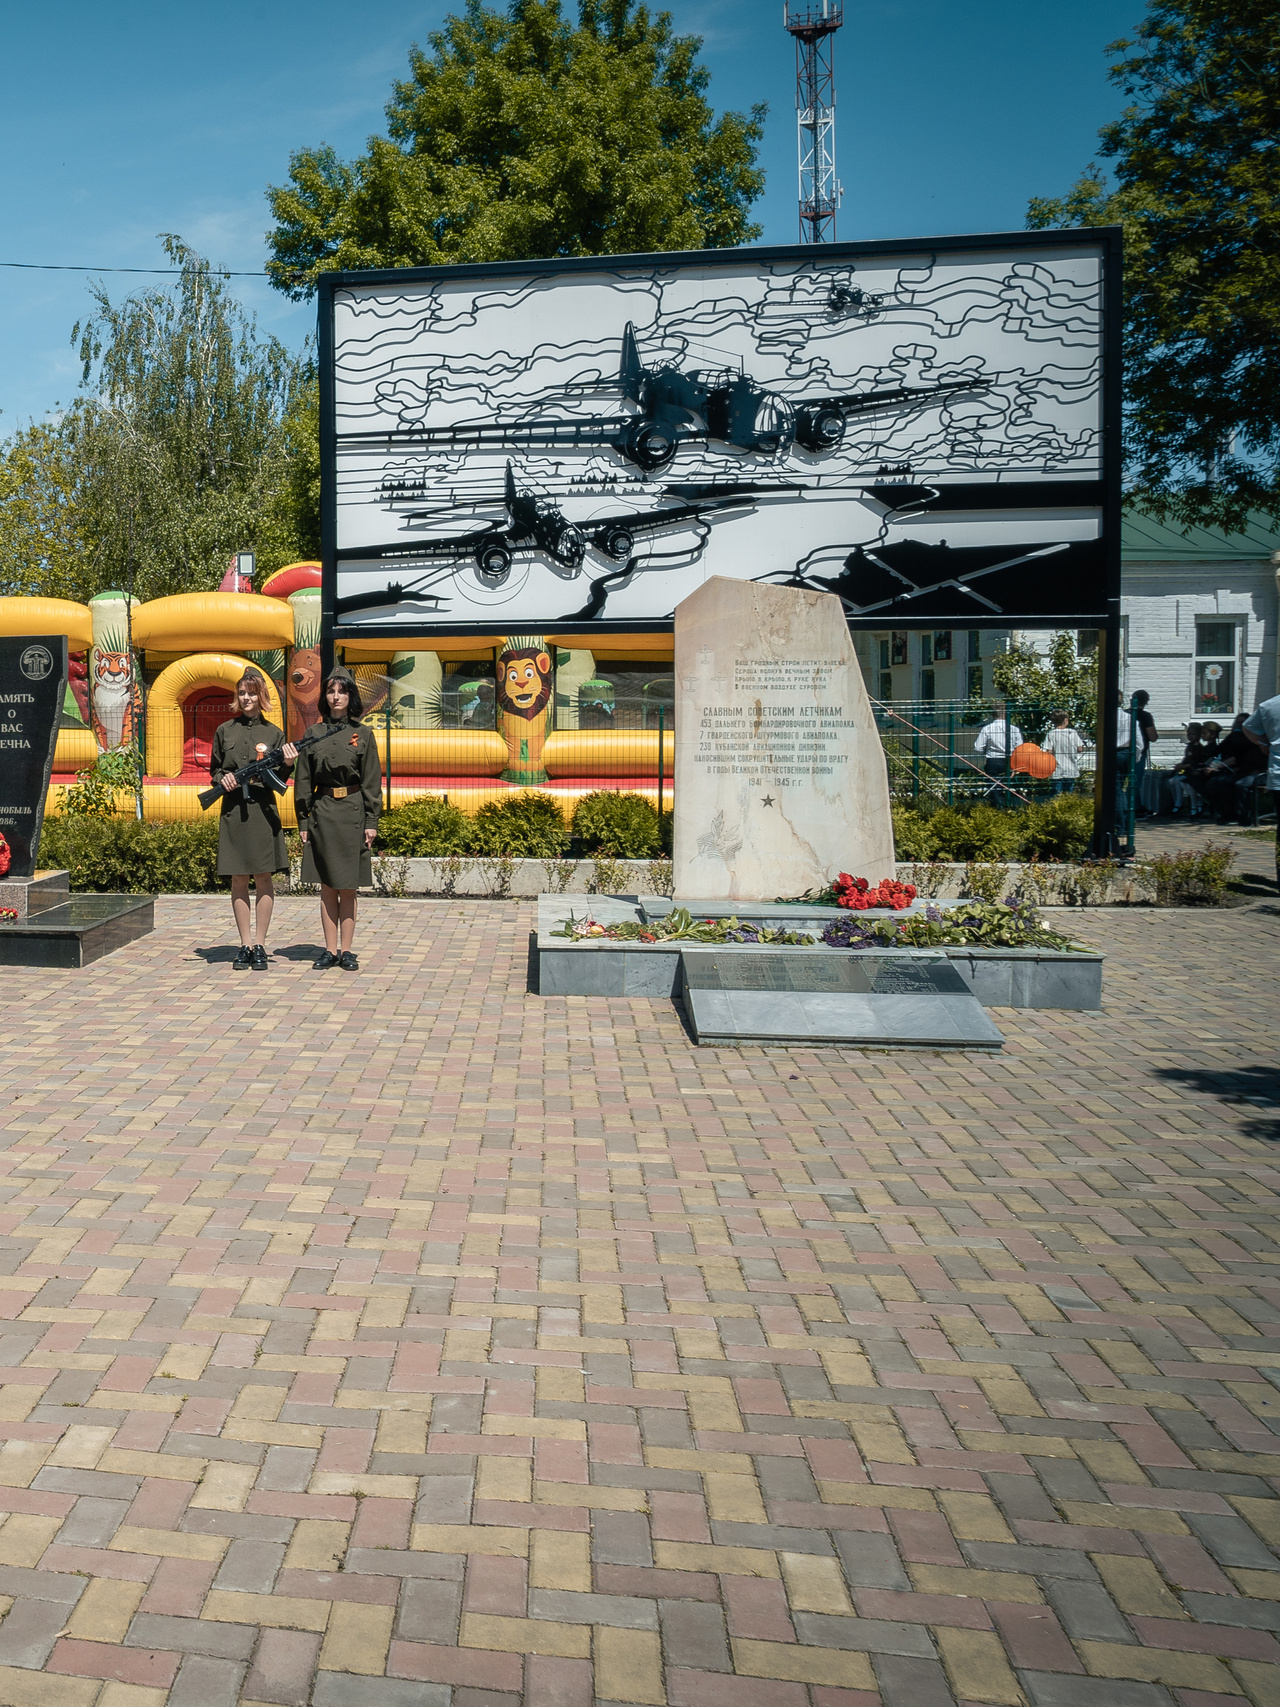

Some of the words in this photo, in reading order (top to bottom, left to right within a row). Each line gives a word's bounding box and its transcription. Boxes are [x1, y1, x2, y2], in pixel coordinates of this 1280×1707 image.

[7, 709, 16, 718] О
[703, 707, 742, 716] СЛАВНЫМ
[748, 707, 794, 716] СОВЕТСКИМ
[800, 707, 842, 716] ЛЕТЧИКАМ
[0, 723, 23, 732] ВАС
[700, 719, 711, 728] 453
[700, 731, 704, 739] 7
[700, 742, 711, 751] 230
[753, 743, 795, 751] АВИАЦИОННОЙ
[738, 755, 795, 763] СОКРУШИТЕЛЬНЫЕ
[749, 778, 762, 786] 1941
[775, 778, 790, 786] 1945
